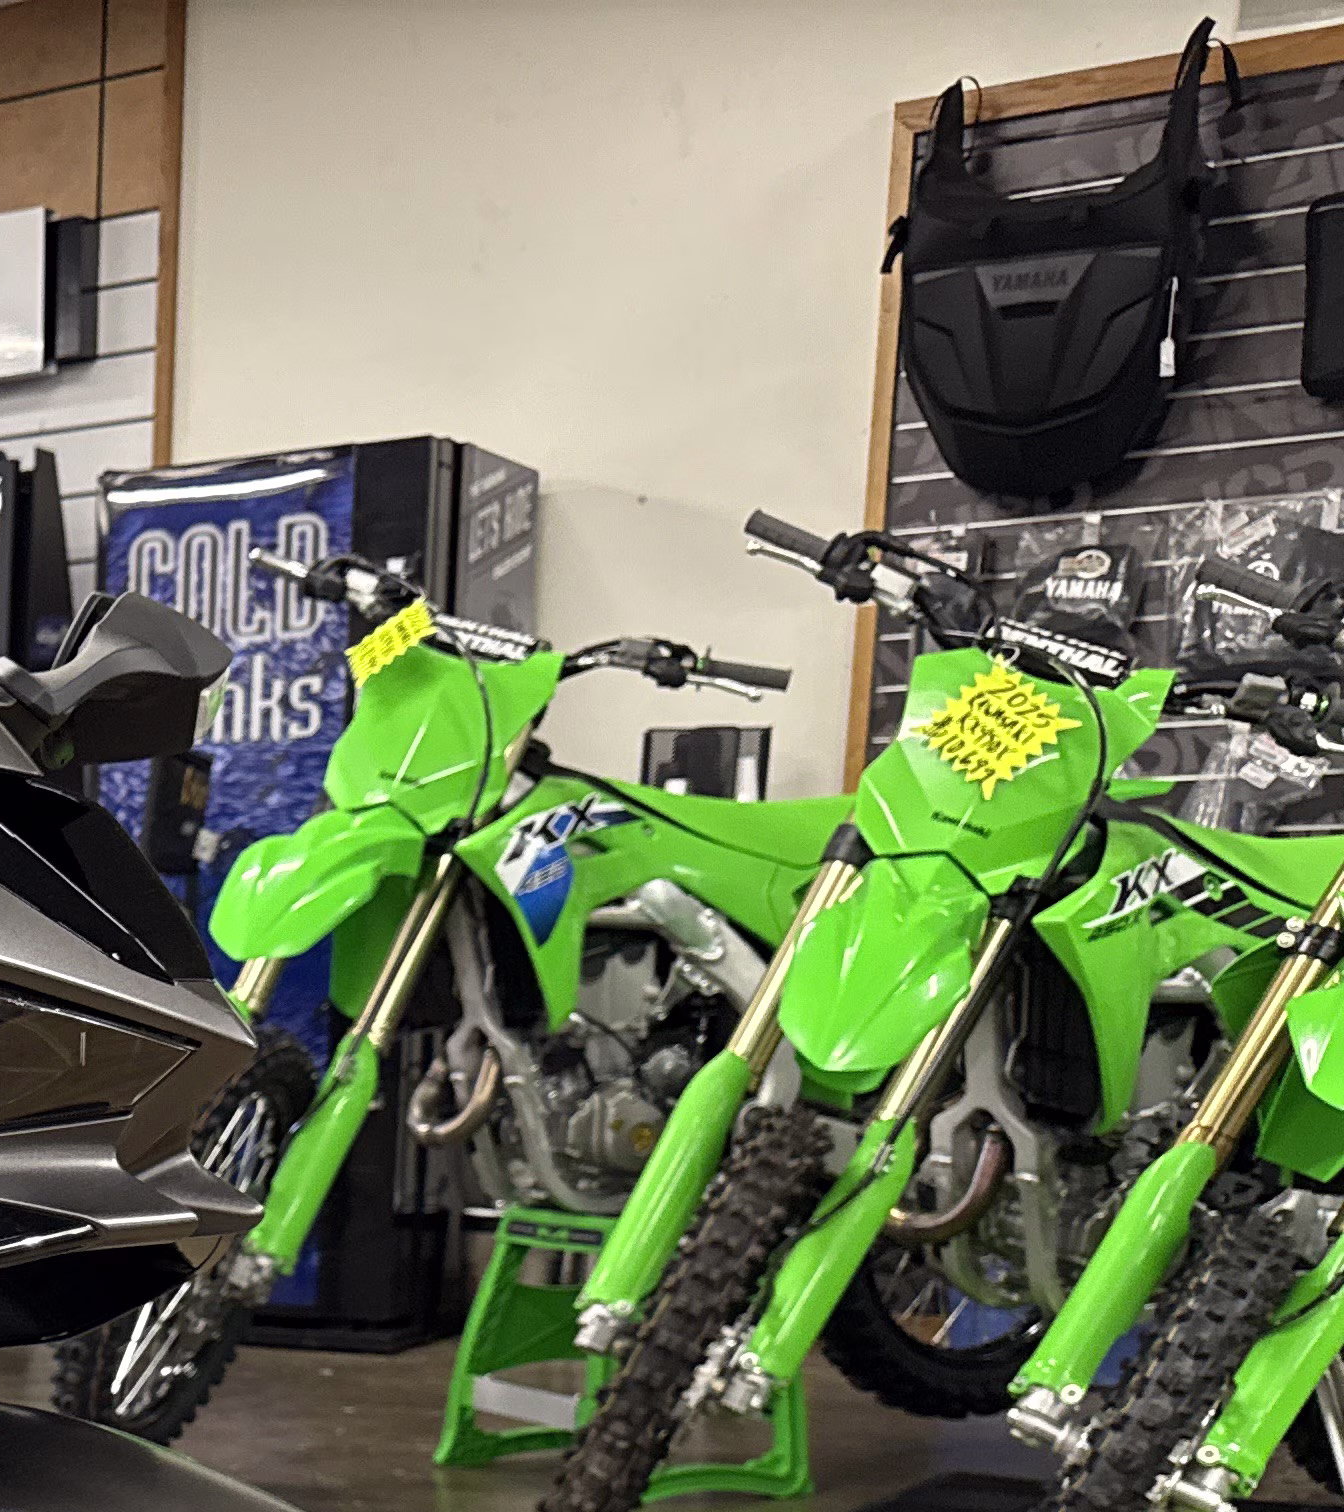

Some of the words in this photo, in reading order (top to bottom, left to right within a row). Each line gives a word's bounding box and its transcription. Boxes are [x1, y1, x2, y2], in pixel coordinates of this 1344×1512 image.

[992, 268, 1069, 292] YAMAHA
[128, 512, 329, 644] COLD
[1046, 576, 1124, 602] YAMAHA
[212, 652, 323, 744] nks
[985, 678, 1056, 729] 2025
[1111, 850, 1175, 915] KX
